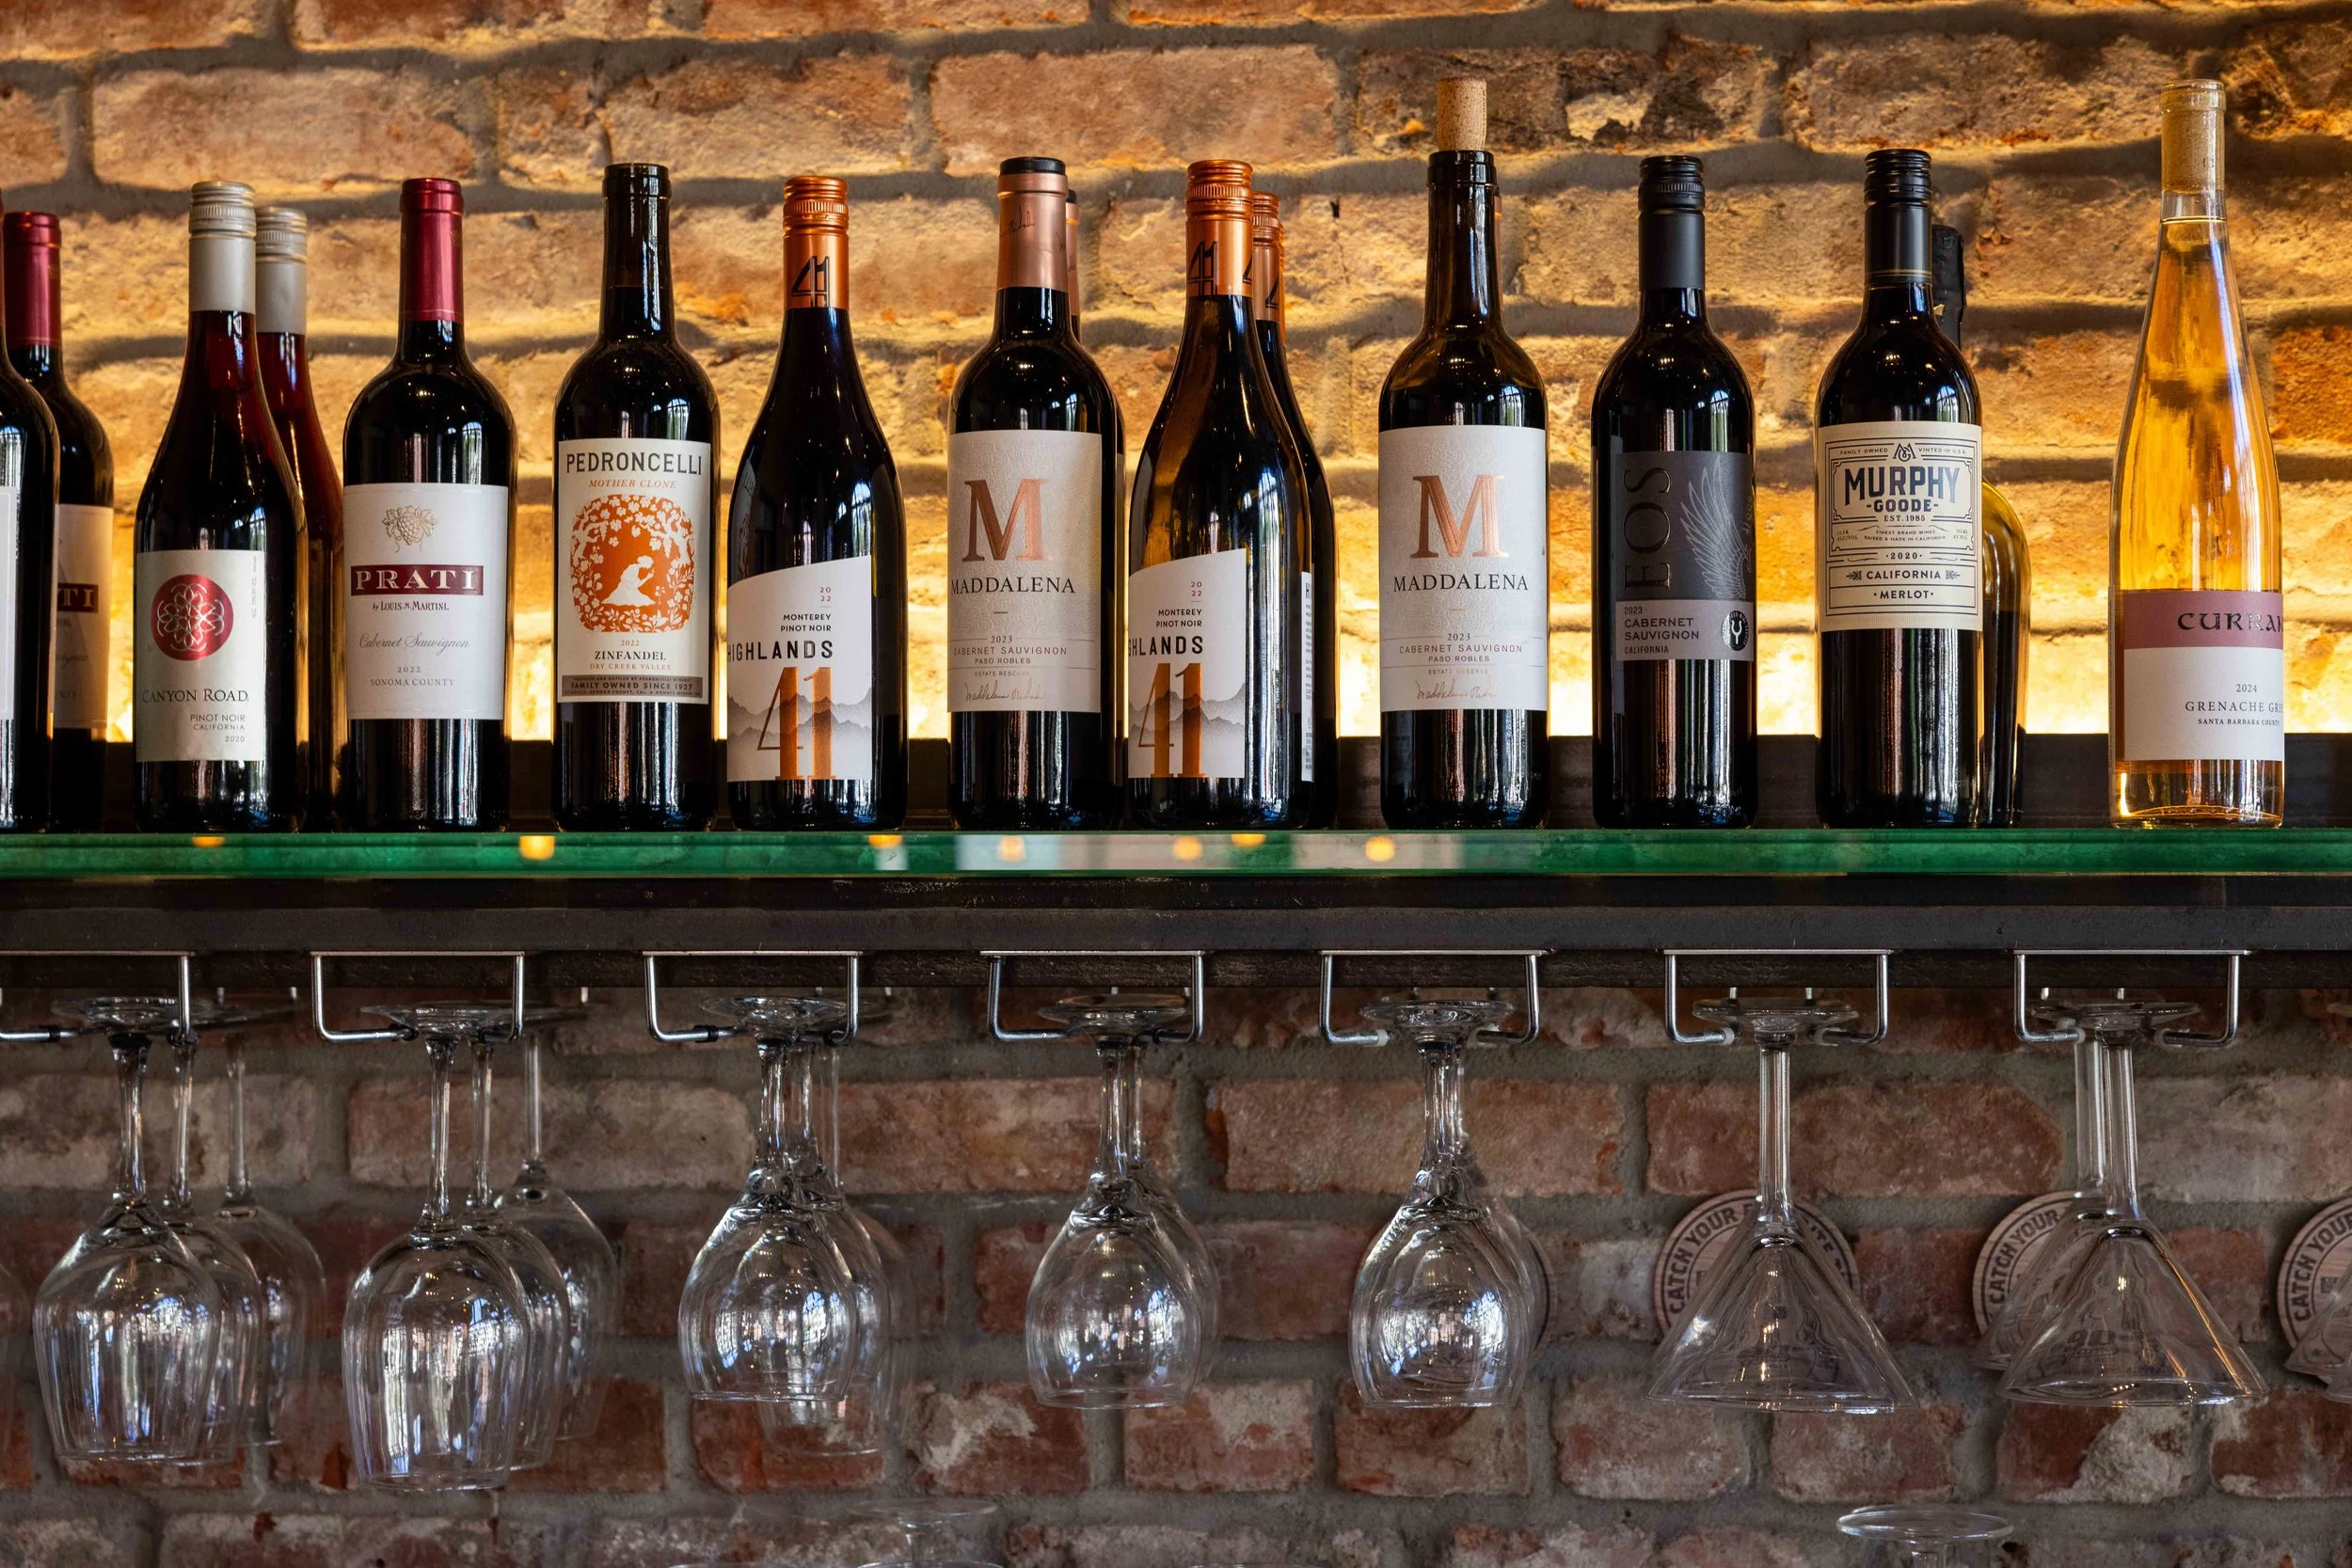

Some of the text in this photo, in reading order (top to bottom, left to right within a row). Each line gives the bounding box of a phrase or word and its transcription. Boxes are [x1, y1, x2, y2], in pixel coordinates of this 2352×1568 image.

[566, 451, 702, 475] PEDRONCELLI
[588, 480, 677, 489] MOTHER CLONE
[1845, 467, 1960, 506] MURPHY
[962, 479, 1050, 562] M
[1410, 475, 1509, 558] M
[1624, 467, 1671, 590] EOS
[356, 569, 476, 591] PRATI
[1393, 574, 1529, 592] MADDALENA
[1867, 570, 1941, 579] CALIFORNIA
[951, 577, 1076, 594] MADDALENA
[381, 601, 401, 610] LOUIS
[1624, 606, 1643, 614] 2023
[1625, 617, 1694, 628] CABERNET
[359, 632, 469, 656] Cabernet Sauvignon
[1625, 630, 1699, 641] SAUVIGNON
[595, 650, 666, 660] ZINFANDEL
[953, 646, 1067, 657] CABERNET SAUVIGNON
[1399, 644, 1522, 654] CABERNET SAUVIGNON
[1625, 645, 1669, 655] CALIFORNIA
[143, 689, 197, 704] CANYON
[2236, 684, 2257, 692] 2024
[2185, 701, 2265, 712] GRENACHE
[757, 667, 836, 780] 41
[1138, 663, 1205, 778] 41
[1667, 1207, 1739, 1315] CATCH YOUR
[1989, 1209, 2060, 1305] CATCH YOUR
[2292, 1254, 2316, 1323] CATCH
